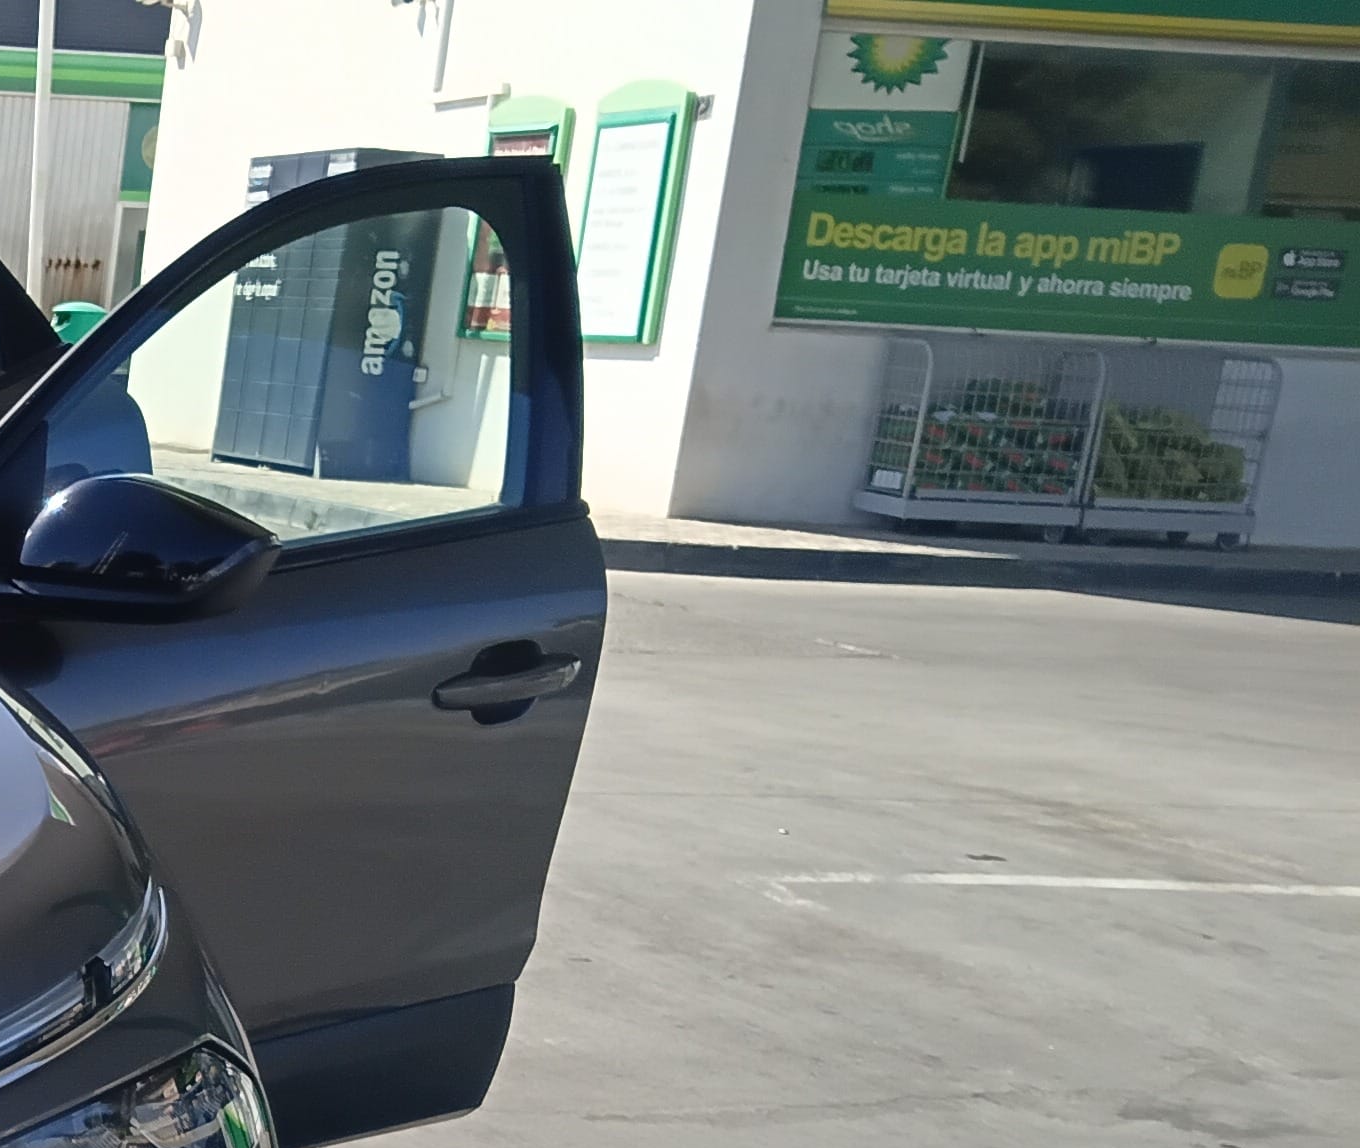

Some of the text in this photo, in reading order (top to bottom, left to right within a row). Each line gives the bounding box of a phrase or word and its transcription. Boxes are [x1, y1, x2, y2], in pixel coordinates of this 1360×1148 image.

[806, 211, 1180, 268] Descarga la app miBP
[803, 259, 1193, 304] Usa tu tarjeta virtual y ahorra siempre
[361, 250, 401, 377] amazon
